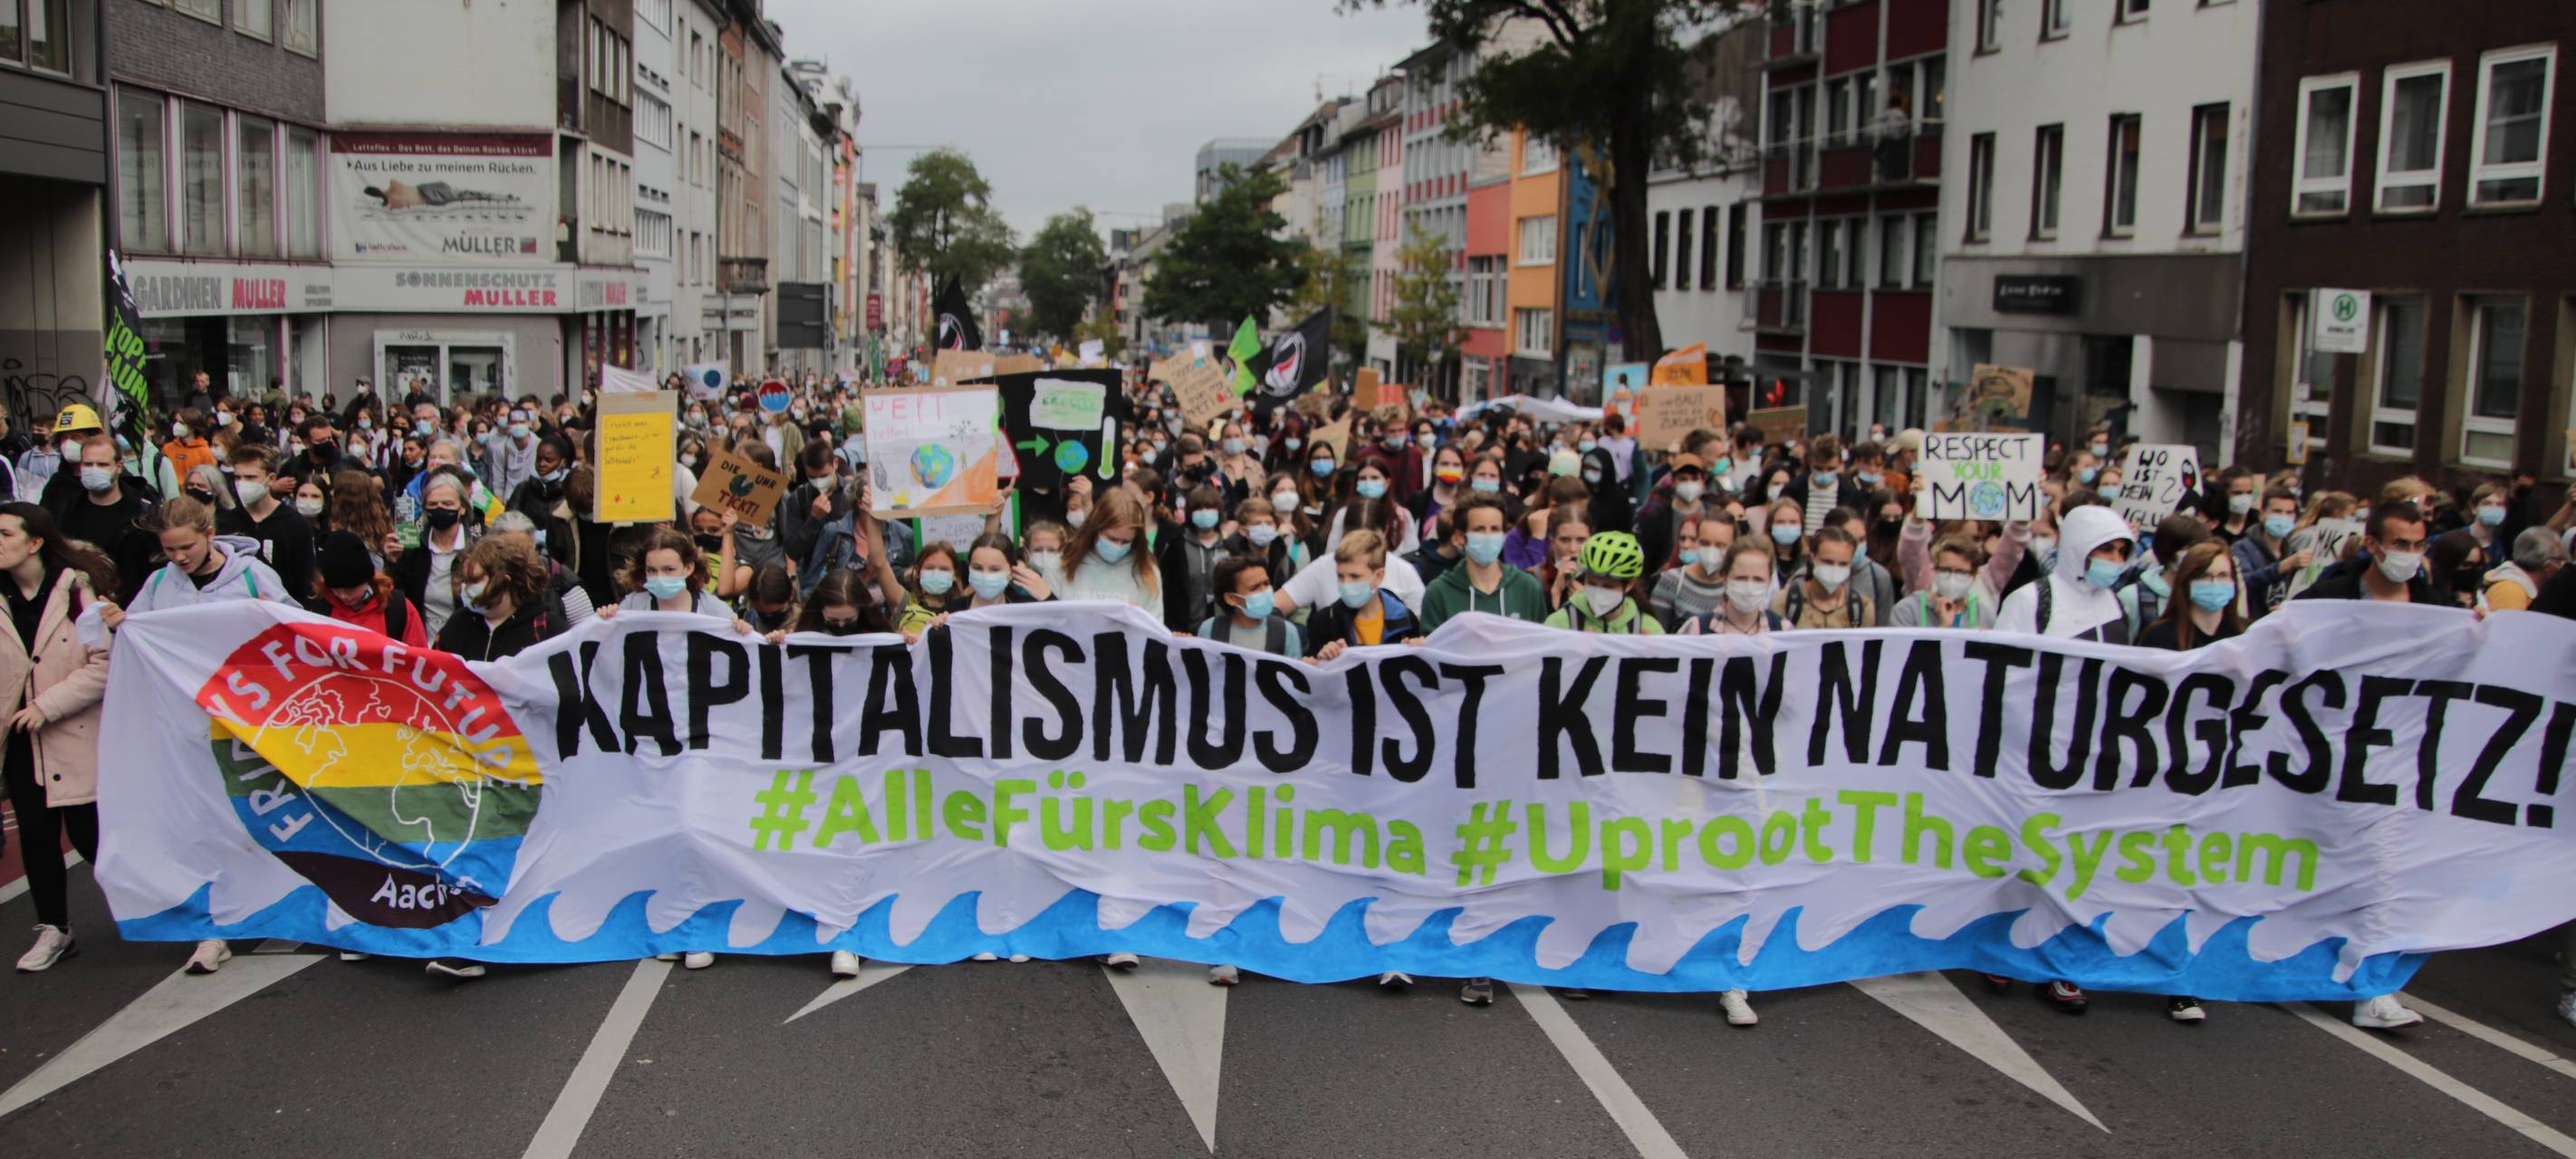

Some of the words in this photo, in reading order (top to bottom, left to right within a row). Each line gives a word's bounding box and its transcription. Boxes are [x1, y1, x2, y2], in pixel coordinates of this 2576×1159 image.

[354, 159, 378, 171] Aus
[381, 159, 414, 172] Liebe
[418, 163, 432, 172] zu
[436, 161, 485, 173] meinem
[488, 162, 537, 174] Rücken.
[442, 230, 515, 254] MÜLLER
[133, 274, 222, 311] GARDINEN
[395, 272, 557, 288] SONNENSCHUTZ
[1926, 435, 2031, 461] RESPECT
[2139, 450, 2167, 466] WO
[720, 459, 741, 474] DIE
[755, 474, 777, 490] UHR
[1950, 462, 2002, 480] YOUR
[2134, 469, 2161, 482] IST
[718, 489, 761, 518] TICKT!
[2119, 483, 2154, 501] MEIN
[272, 634, 370, 684] FOR
[548, 625, 1319, 773] KAPITALISMUS
[1347, 654, 1505, 789] IST
[1537, 649, 1788, 781] KEIN
[1807, 639, 2576, 829] NATURGESETZ!
[749, 769, 1425, 876] #AlleFürsKlima
[1451, 790, 2319, 904] #UprootTheSystem
